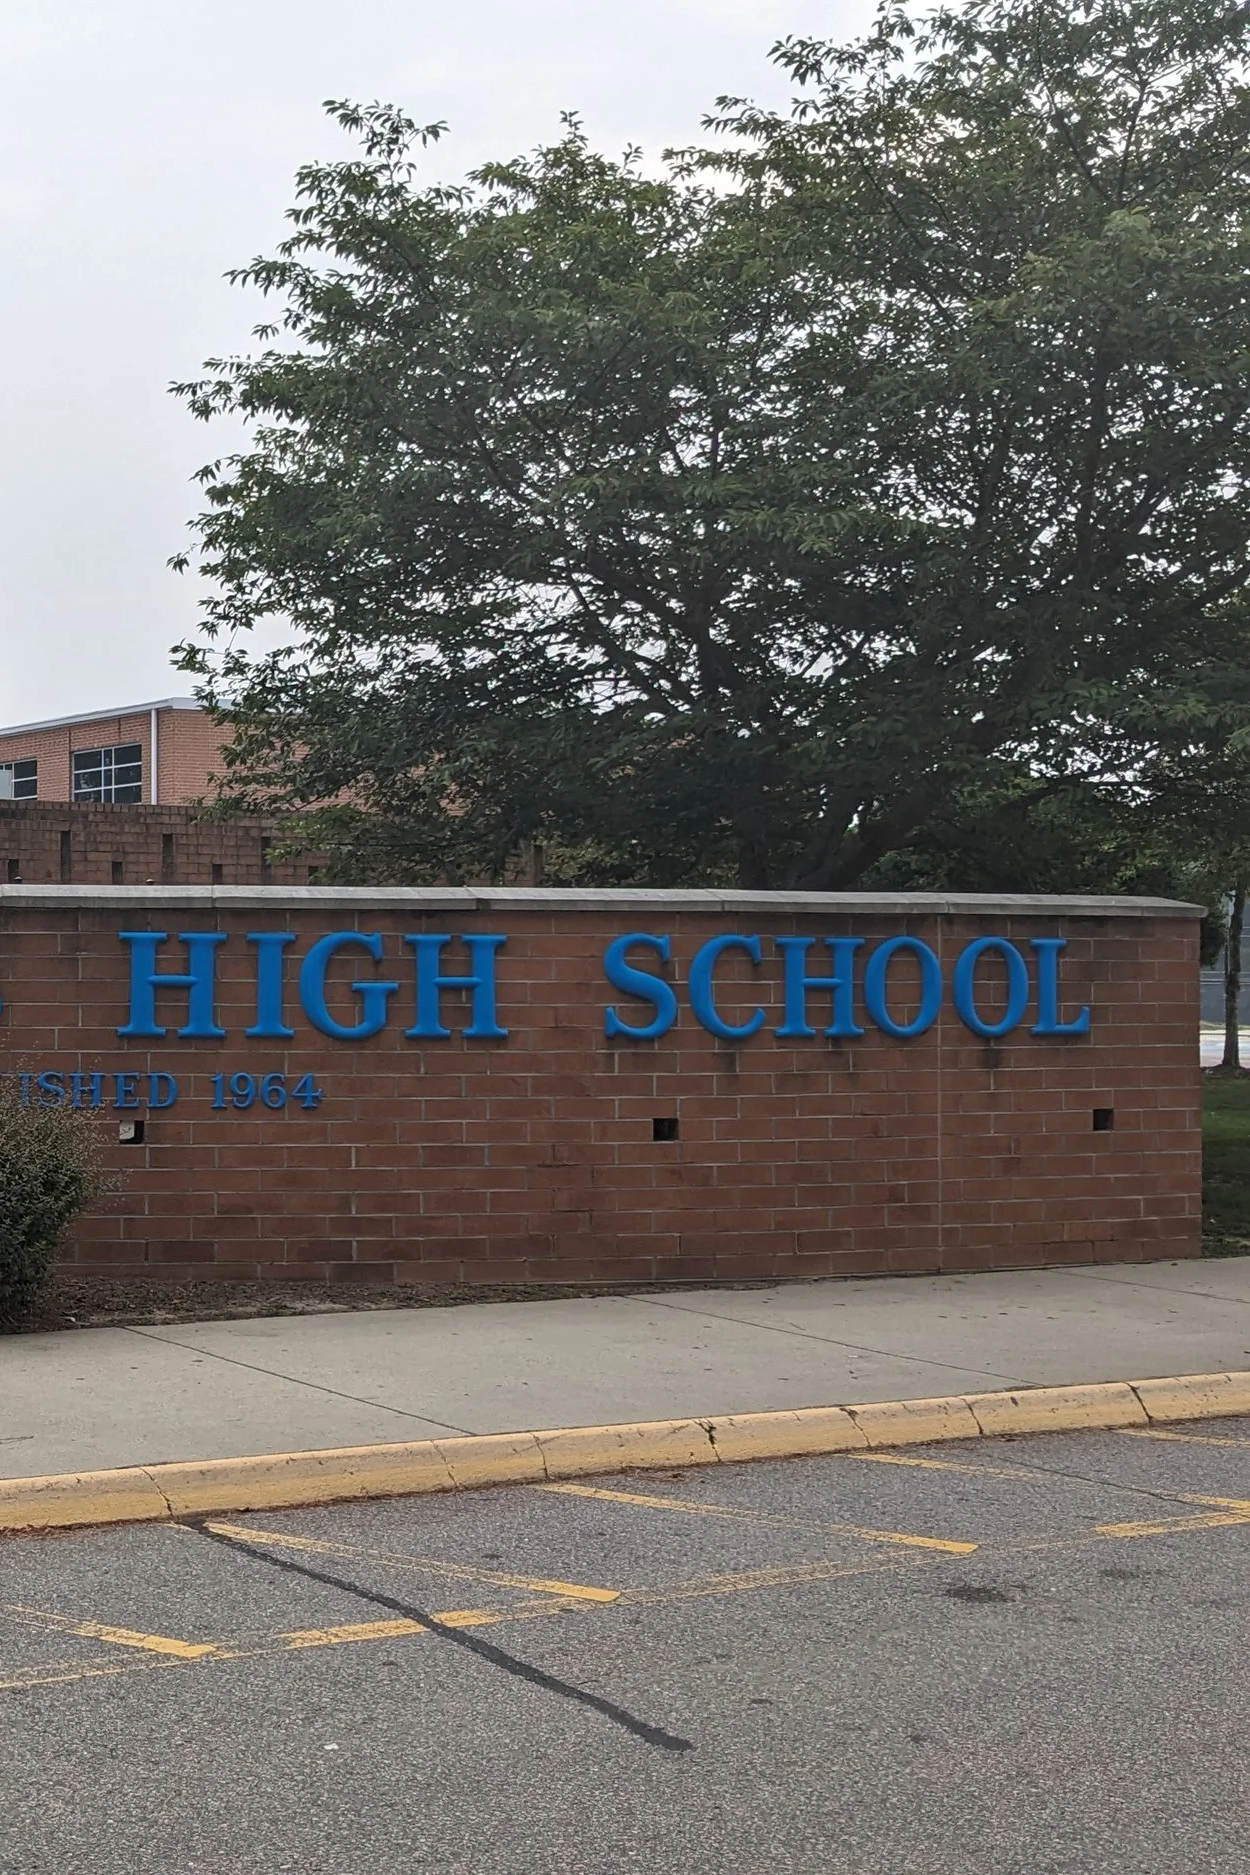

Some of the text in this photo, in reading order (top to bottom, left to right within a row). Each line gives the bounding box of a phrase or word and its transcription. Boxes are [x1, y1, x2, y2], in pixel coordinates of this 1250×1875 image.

[117, 931, 509, 1041] HIGH
[603, 932, 1091, 1041] SCHOOL
[210, 1071, 324, 1110] 1964
